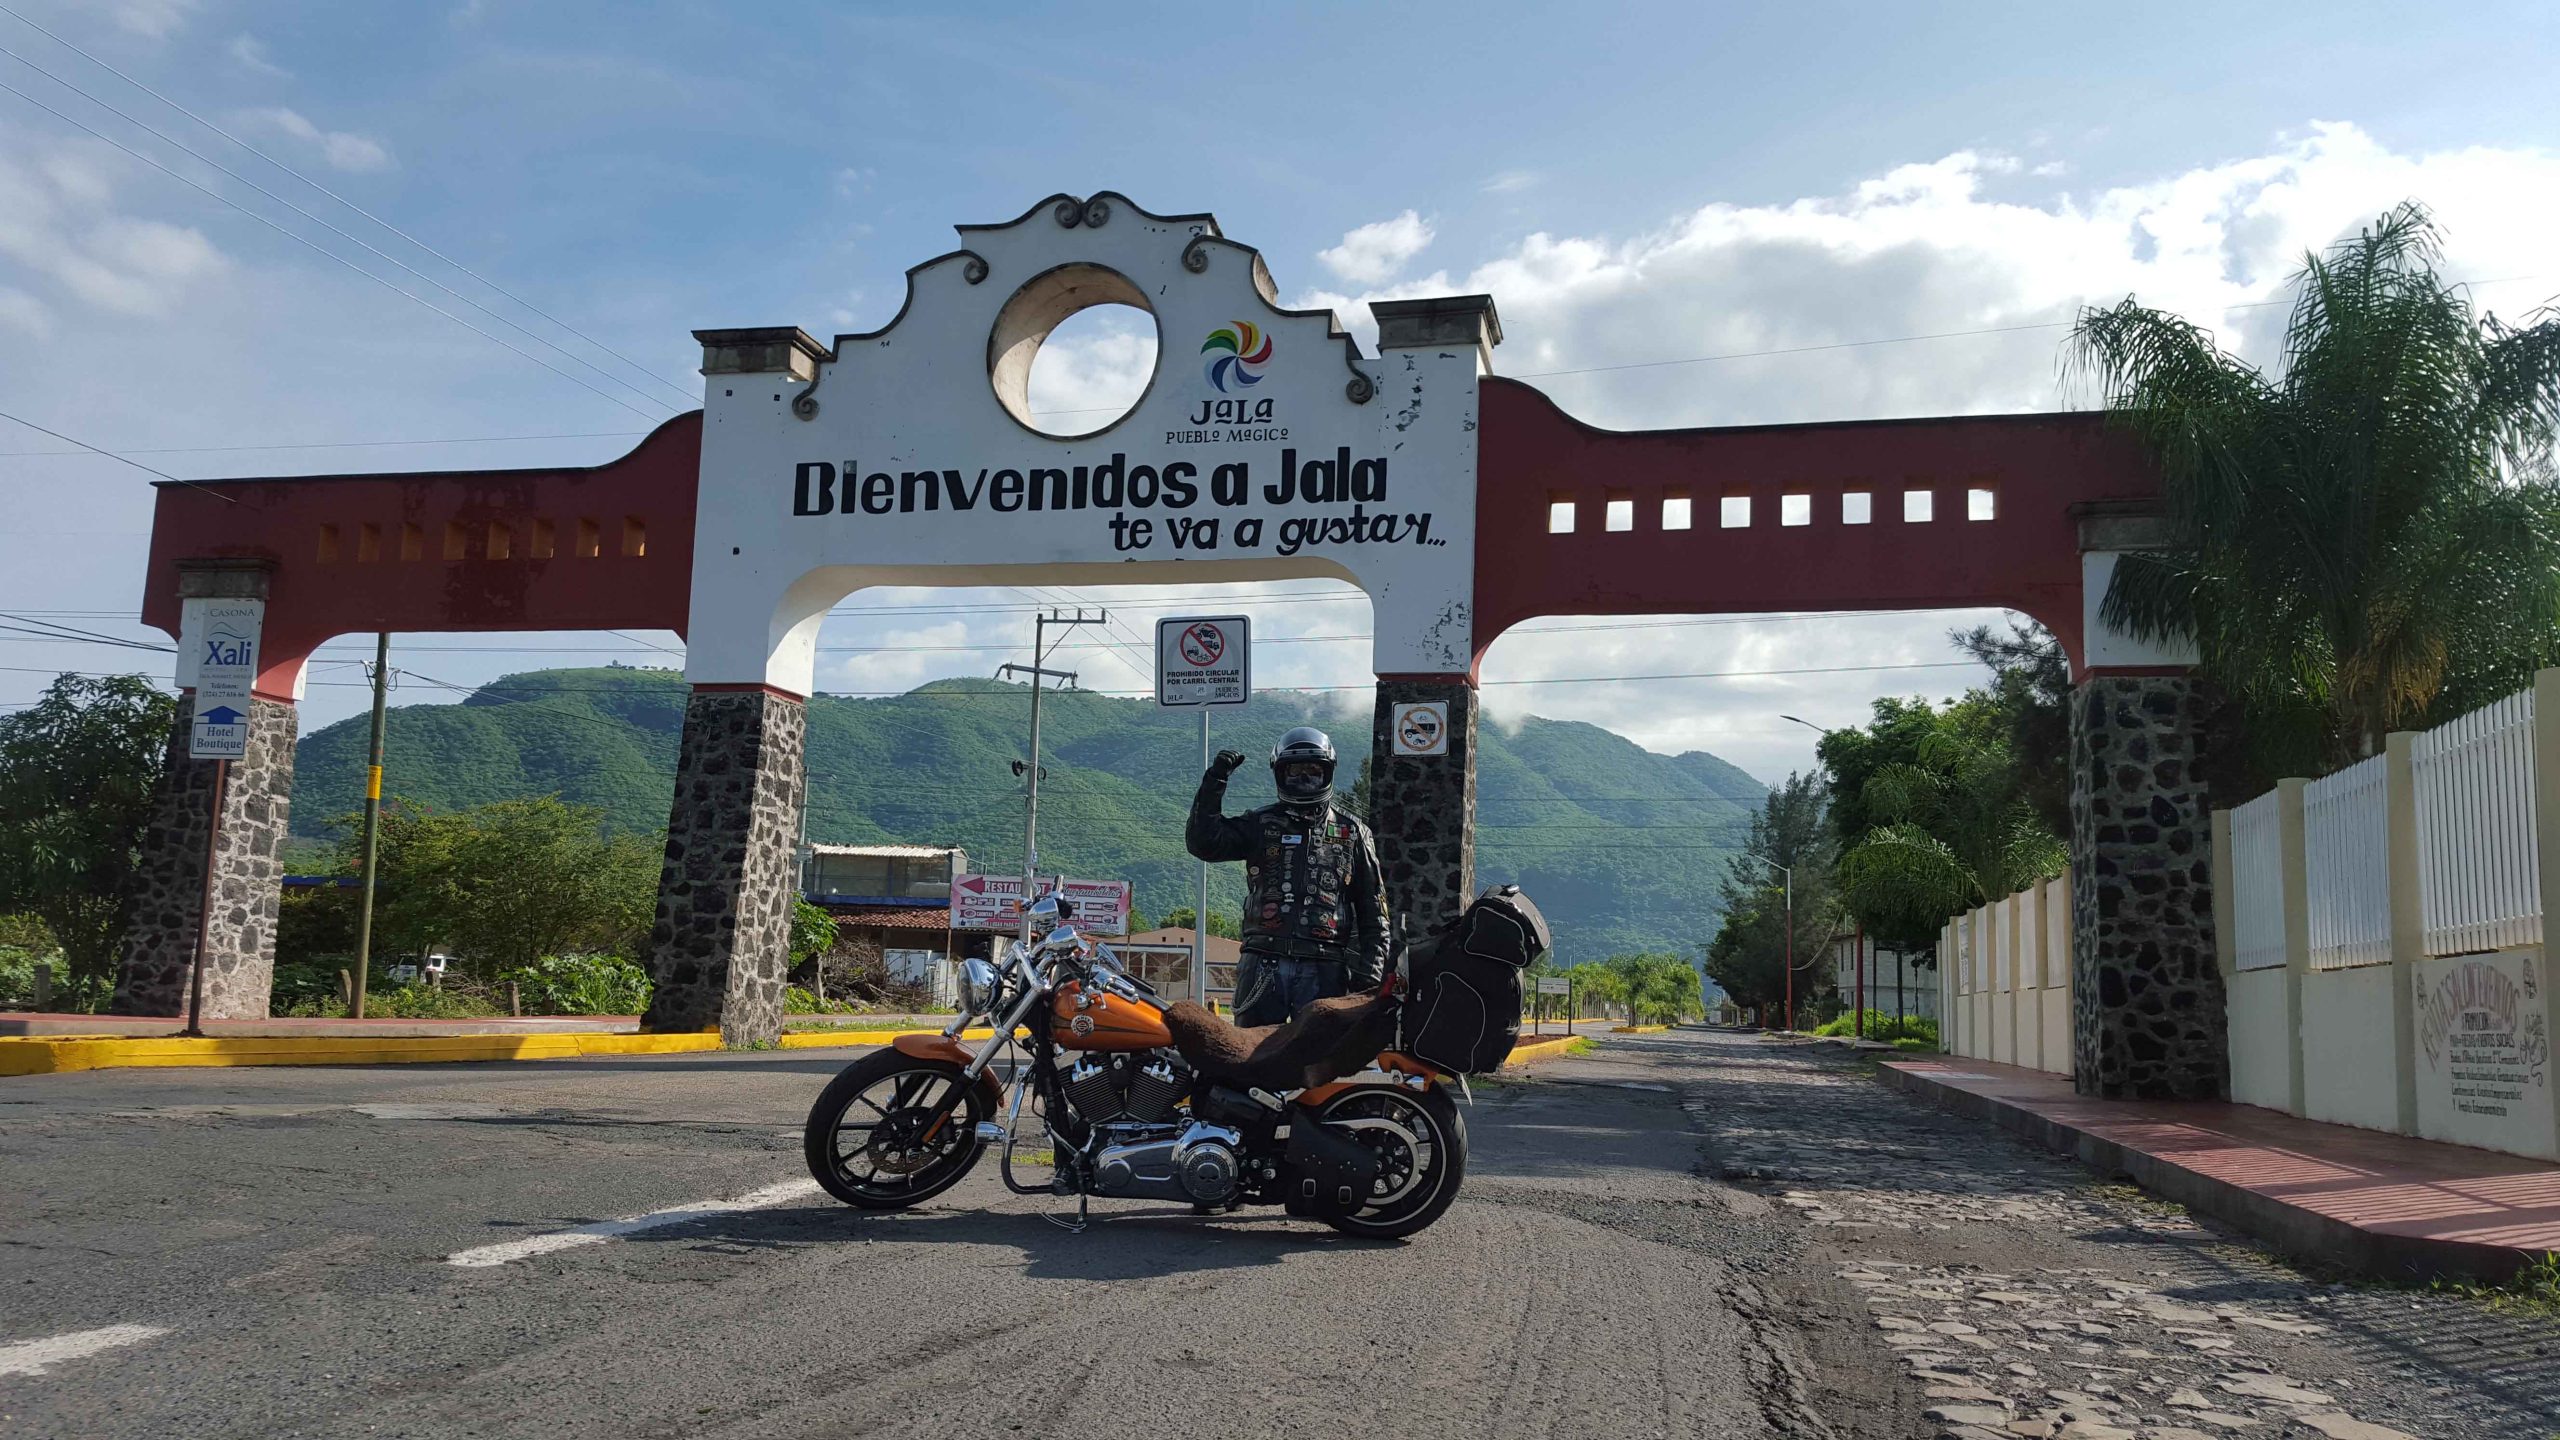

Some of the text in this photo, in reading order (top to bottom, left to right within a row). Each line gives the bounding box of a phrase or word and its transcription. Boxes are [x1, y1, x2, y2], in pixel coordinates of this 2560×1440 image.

[792, 446, 1387, 516] Bienvenidos a Jala
[1109, 511, 1152, 551] te
[1169, 514, 1219, 550] va
[1234, 516, 1262, 548] a
[210, 608, 255, 618] CASONA
[203, 641, 252, 666] Xali
[1167, 669, 1239, 678] PROHIBIDO CIRCULAR
[1182, 677, 1207, 685] CARRIL
[1209, 676, 1240, 684] CENTRAL
[206, 726, 234, 737] Hotel
[196, 737, 242, 751] Boutique
[984, 882, 1046, 894] RESTAUT
